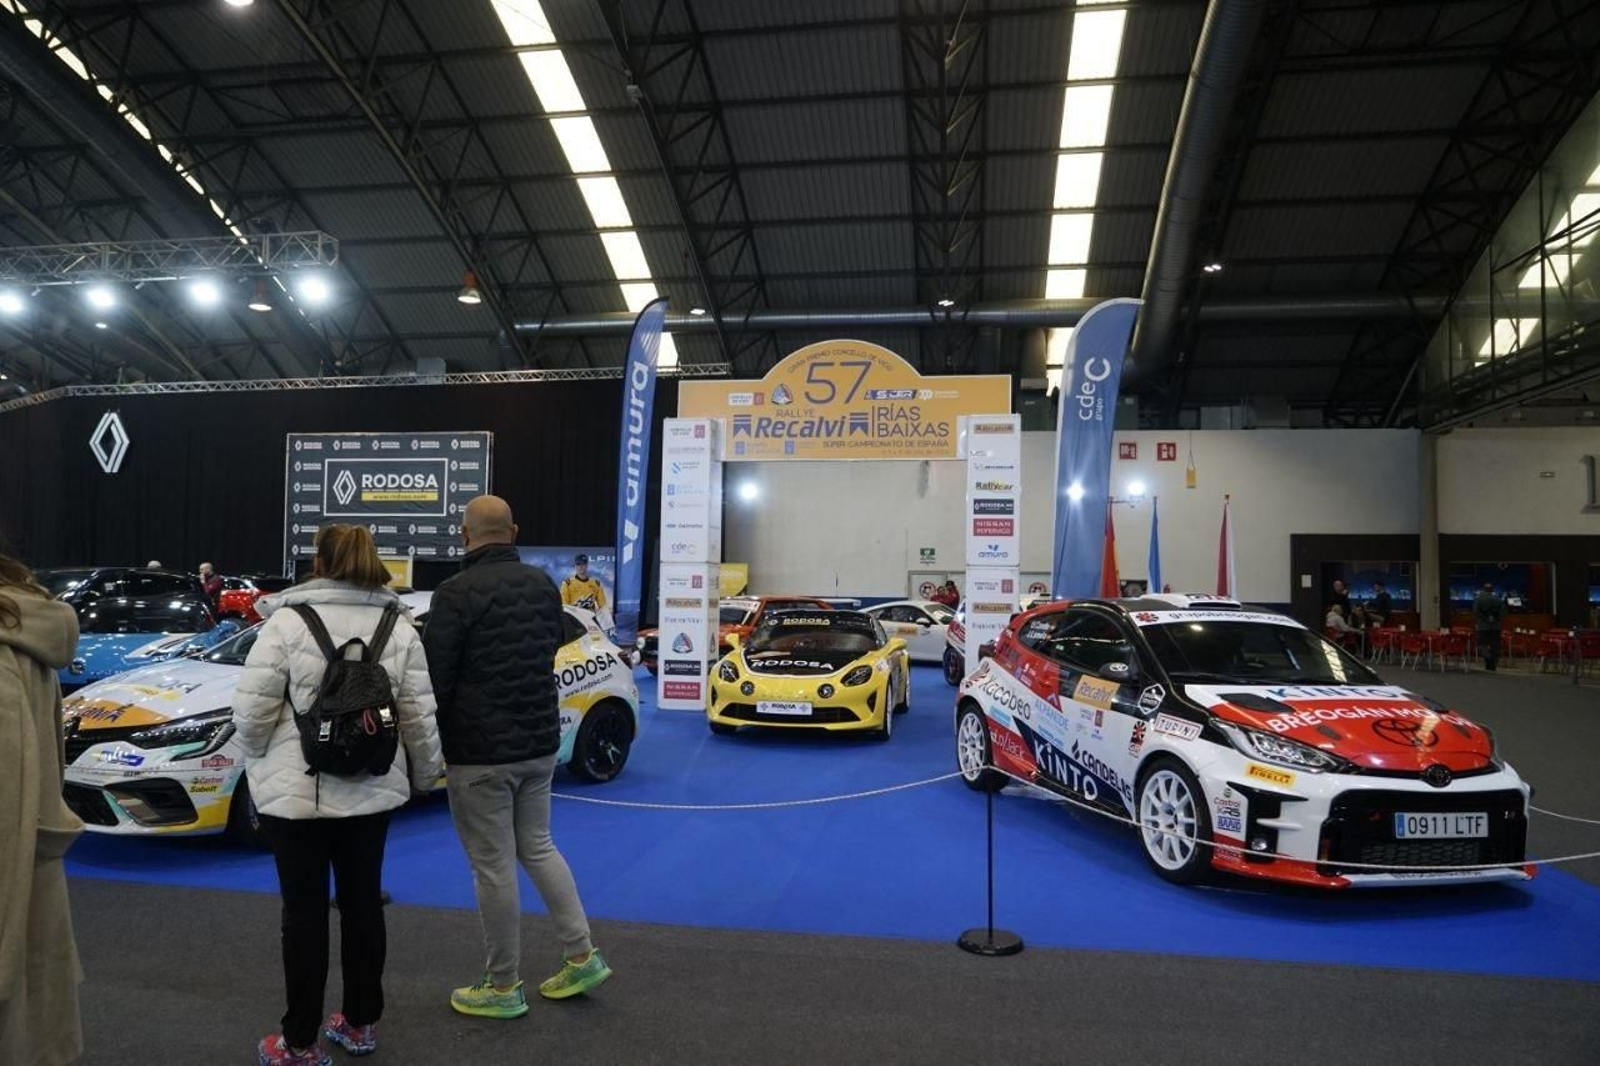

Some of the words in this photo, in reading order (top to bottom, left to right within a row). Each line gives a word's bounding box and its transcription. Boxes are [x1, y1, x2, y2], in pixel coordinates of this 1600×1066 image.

[804, 362, 872, 404] 57
[776, 409, 815, 418] RALLYE
[878, 403, 921, 421] RÍAS
[627, 361, 649, 508] amura
[755, 416, 847, 438] Recalvi
[878, 422, 950, 437] BAIXAS
[361, 474, 439, 488] RODOSA
[553, 652, 618, 689] RODOSA
[751, 659, 834, 671] RODOSA
[1250, 766, 1291, 784] PIRELLI
[1213, 797, 1241, 807] Castrol
[1408, 816, 1449, 835] 0911
[1454, 816, 1485, 835] LTF
